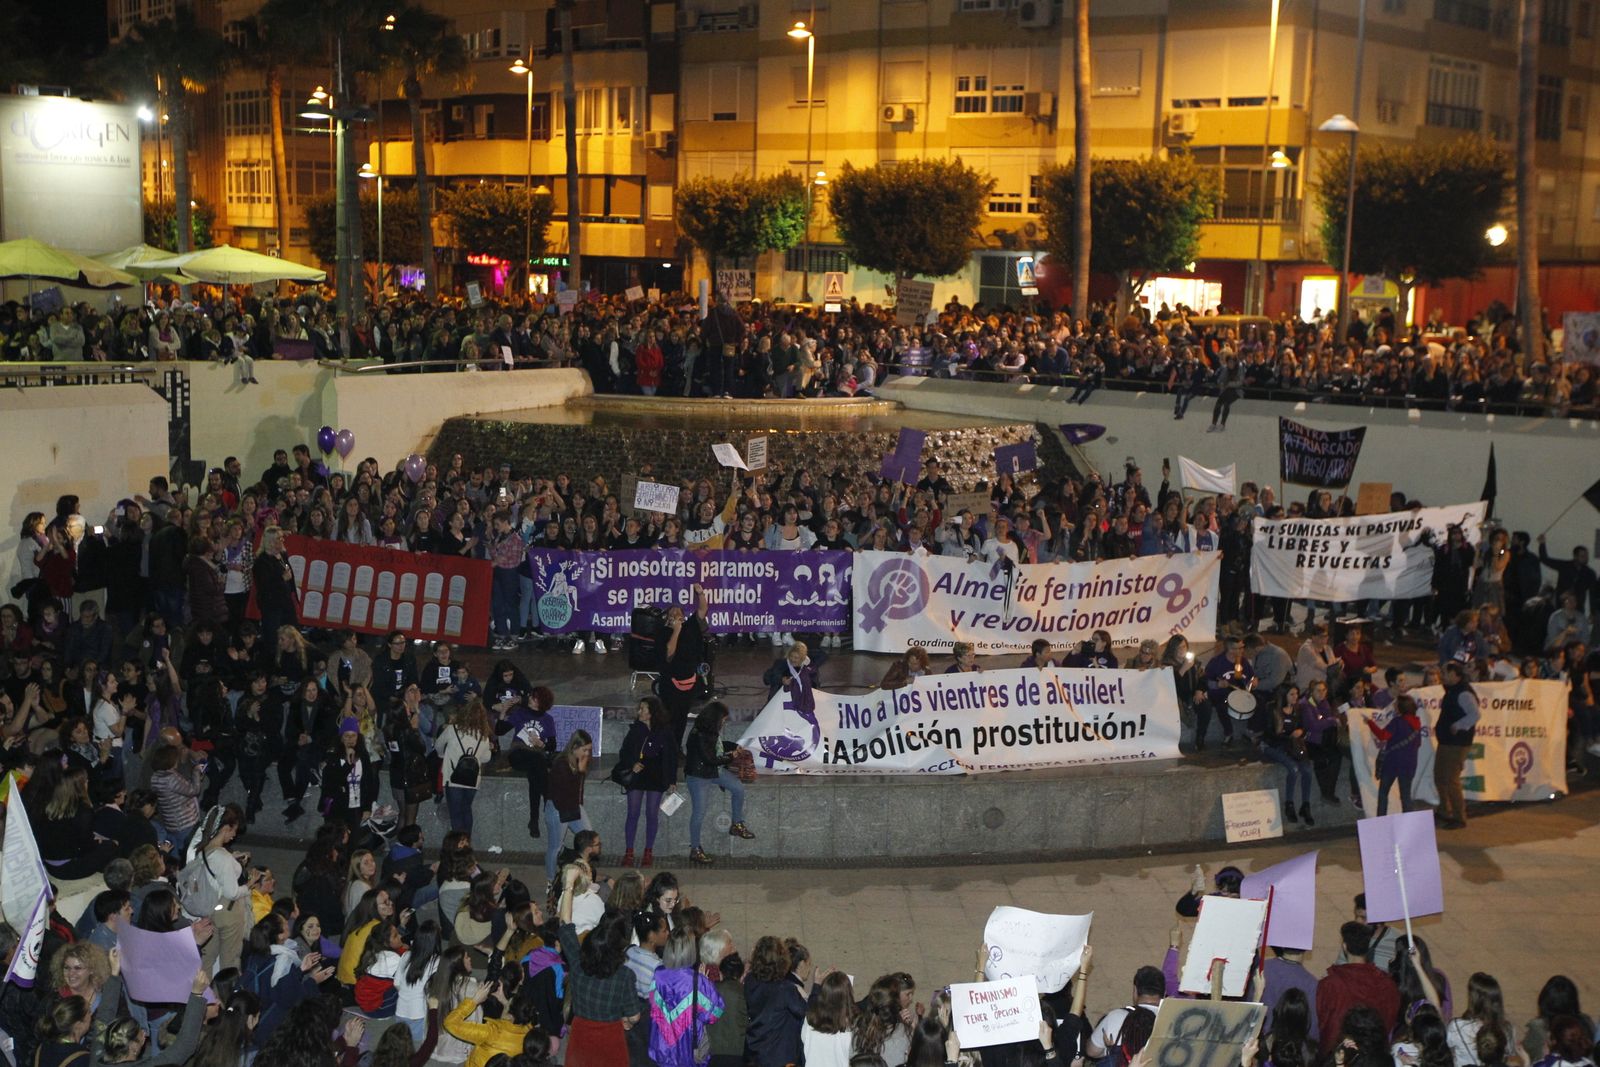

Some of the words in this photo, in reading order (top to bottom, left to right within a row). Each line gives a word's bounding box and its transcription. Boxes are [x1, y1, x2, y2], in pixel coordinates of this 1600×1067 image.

[1278, 523, 1341, 537] SUMISAS
[1345, 525, 1367, 536] NI
[1366, 518, 1424, 536] PASIVAS
[1267, 535, 1331, 553] LIBRES
[1339, 541, 1352, 553] Y
[590, 557, 613, 584] ¡Si
[618, 558, 696, 578] nosotras
[700, 560, 780, 582] paramos,
[1295, 554, 1393, 569] REVUELTAS
[607, 588, 628, 605] se
[633, 586, 673, 608] para
[678, 583, 694, 605] el
[702, 583, 762, 604] mundo!
[932, 571, 1038, 603] Almeía
[1041, 573, 1158, 607] feminista
[592, 612, 632, 627] Asamb
[711, 612, 730, 626] 8M
[732, 611, 775, 626] Almería
[950, 610, 966, 632] y
[970, 602, 1153, 632] revolucionaria
[977, 642, 988, 650] de
[838, 703, 871, 730] ¡No
[890, 689, 921, 716] los
[924, 681, 1009, 712] vientres
[1016, 675, 1040, 706] de
[1046, 675, 1126, 707] alquiler!
[823, 720, 961, 766] ¡Abolición
[973, 712, 1148, 755] prostitución!
[968, 986, 1019, 1006] FEMINISMO
[964, 1012, 989, 1025] TENER
